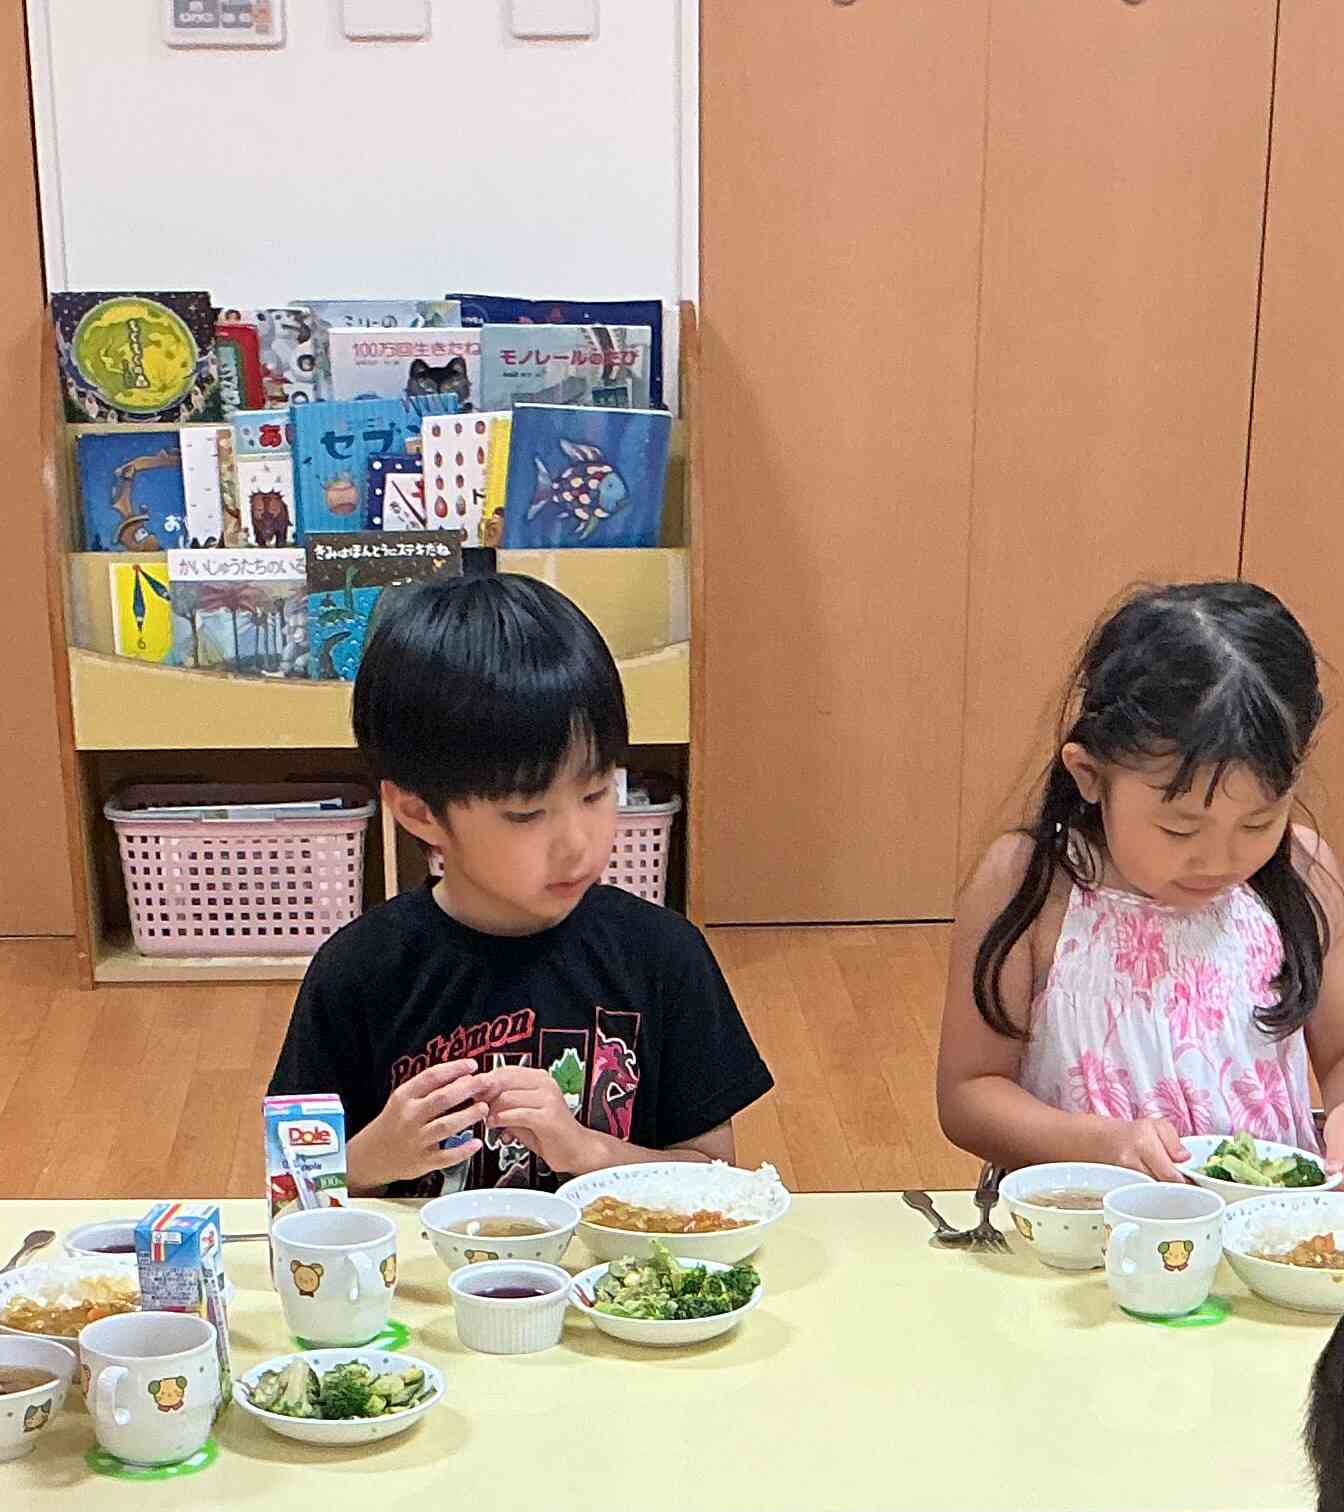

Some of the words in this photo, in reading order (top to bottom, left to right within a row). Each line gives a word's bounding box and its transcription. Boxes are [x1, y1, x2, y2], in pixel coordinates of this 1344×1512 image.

[500, 348, 640, 368] モノレールのたび
[391, 1008, 536, 1088] Pokémon
[288, 1126, 331, 1142] Dole
